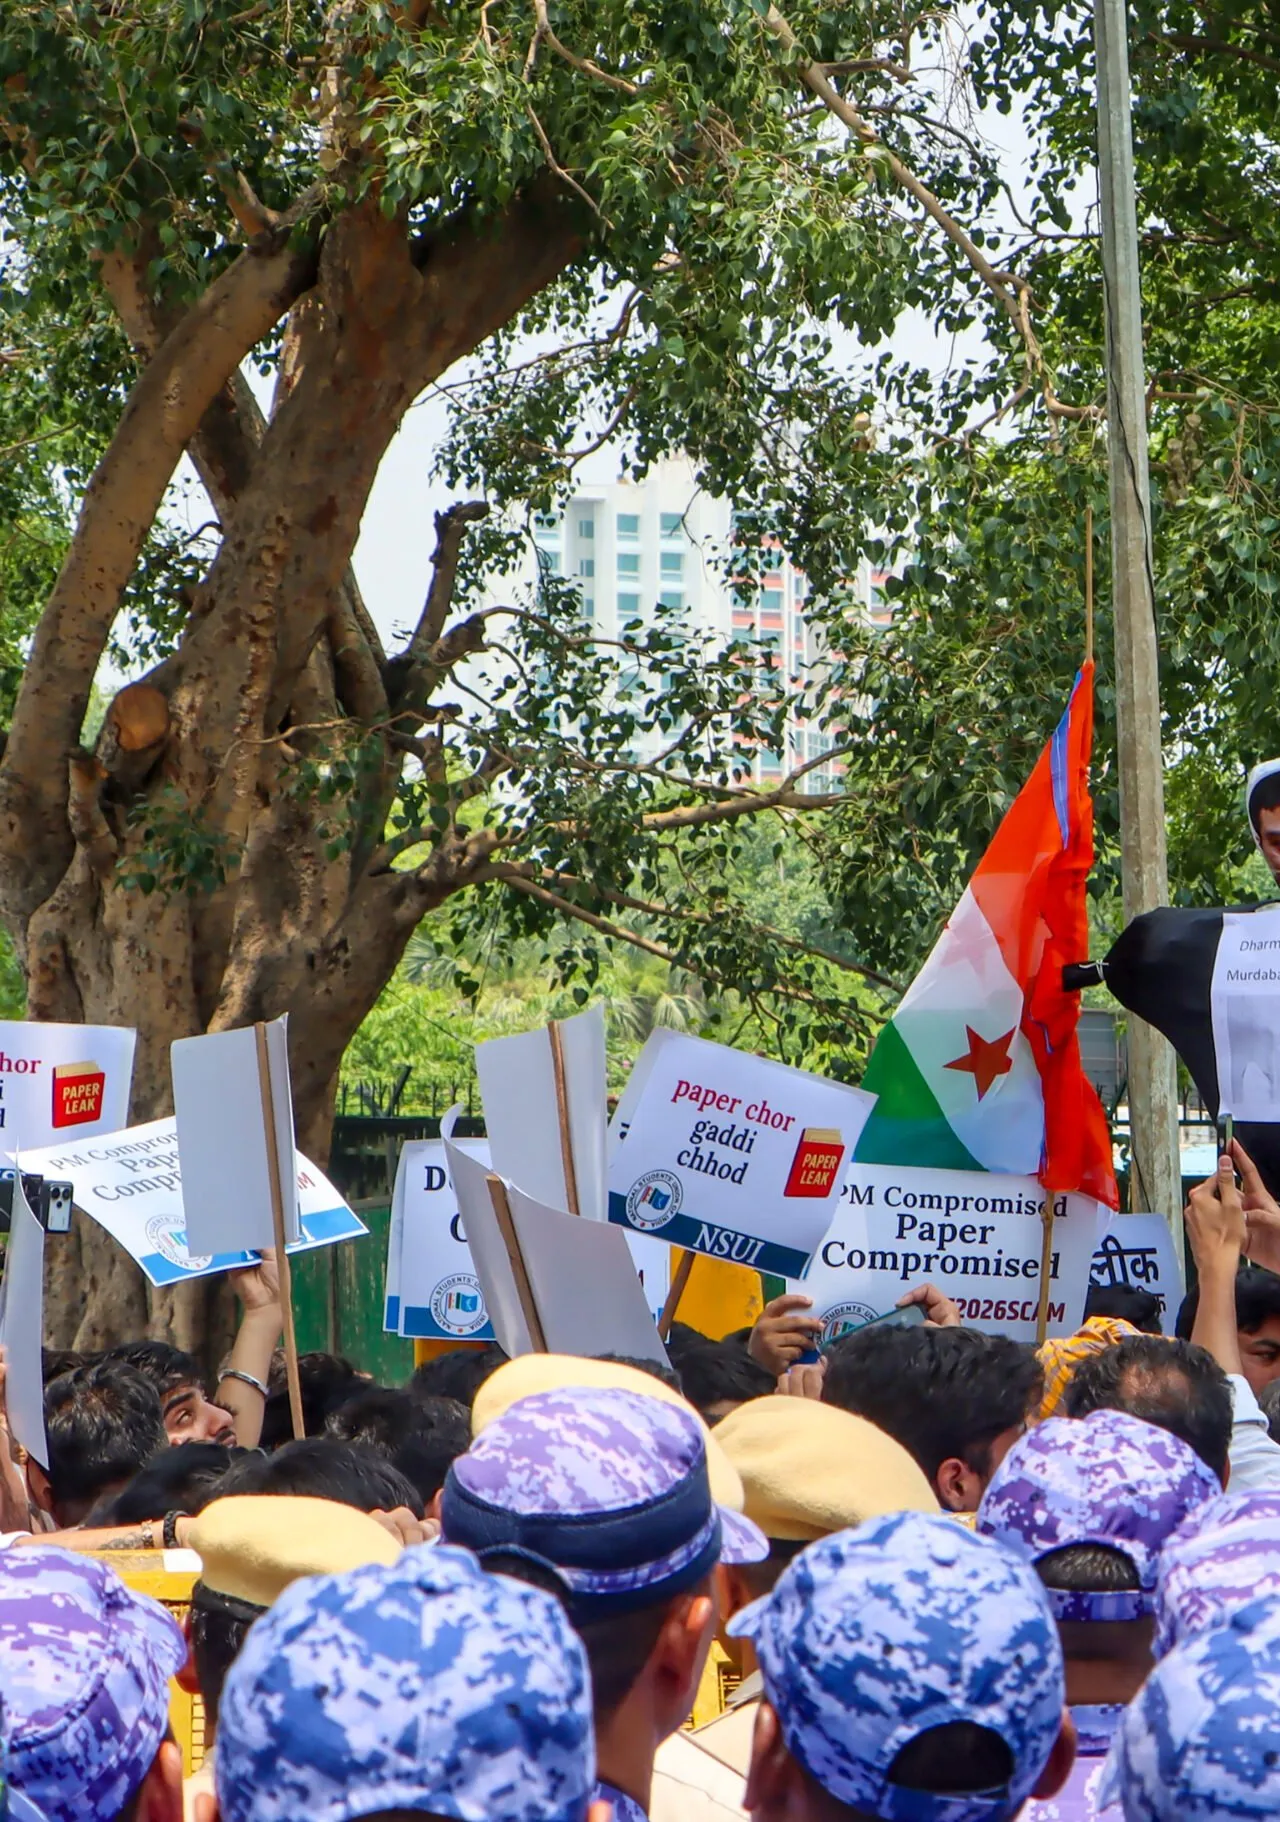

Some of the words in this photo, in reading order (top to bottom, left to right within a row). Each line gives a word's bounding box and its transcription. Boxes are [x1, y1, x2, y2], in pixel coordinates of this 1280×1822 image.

[0, 1052, 41, 1074] hor
[62, 1082, 100, 1101] PAPER
[65, 1098, 96, 1115] LEAK
[670, 1080, 742, 1114] paper
[745, 1100, 796, 1132] chor
[689, 1120, 758, 1154] gaddi
[49, 1154, 90, 1170] PM
[88, 1133, 178, 1161] Compro
[115, 1150, 180, 1173] Pape
[676, 1146, 749, 1185] chhod
[802, 1152, 838, 1170] PAPER
[800, 1169, 830, 1186] LEAK
[692, 1223, 765, 1265] NSUI
[895, 1213, 995, 1251] Paper
